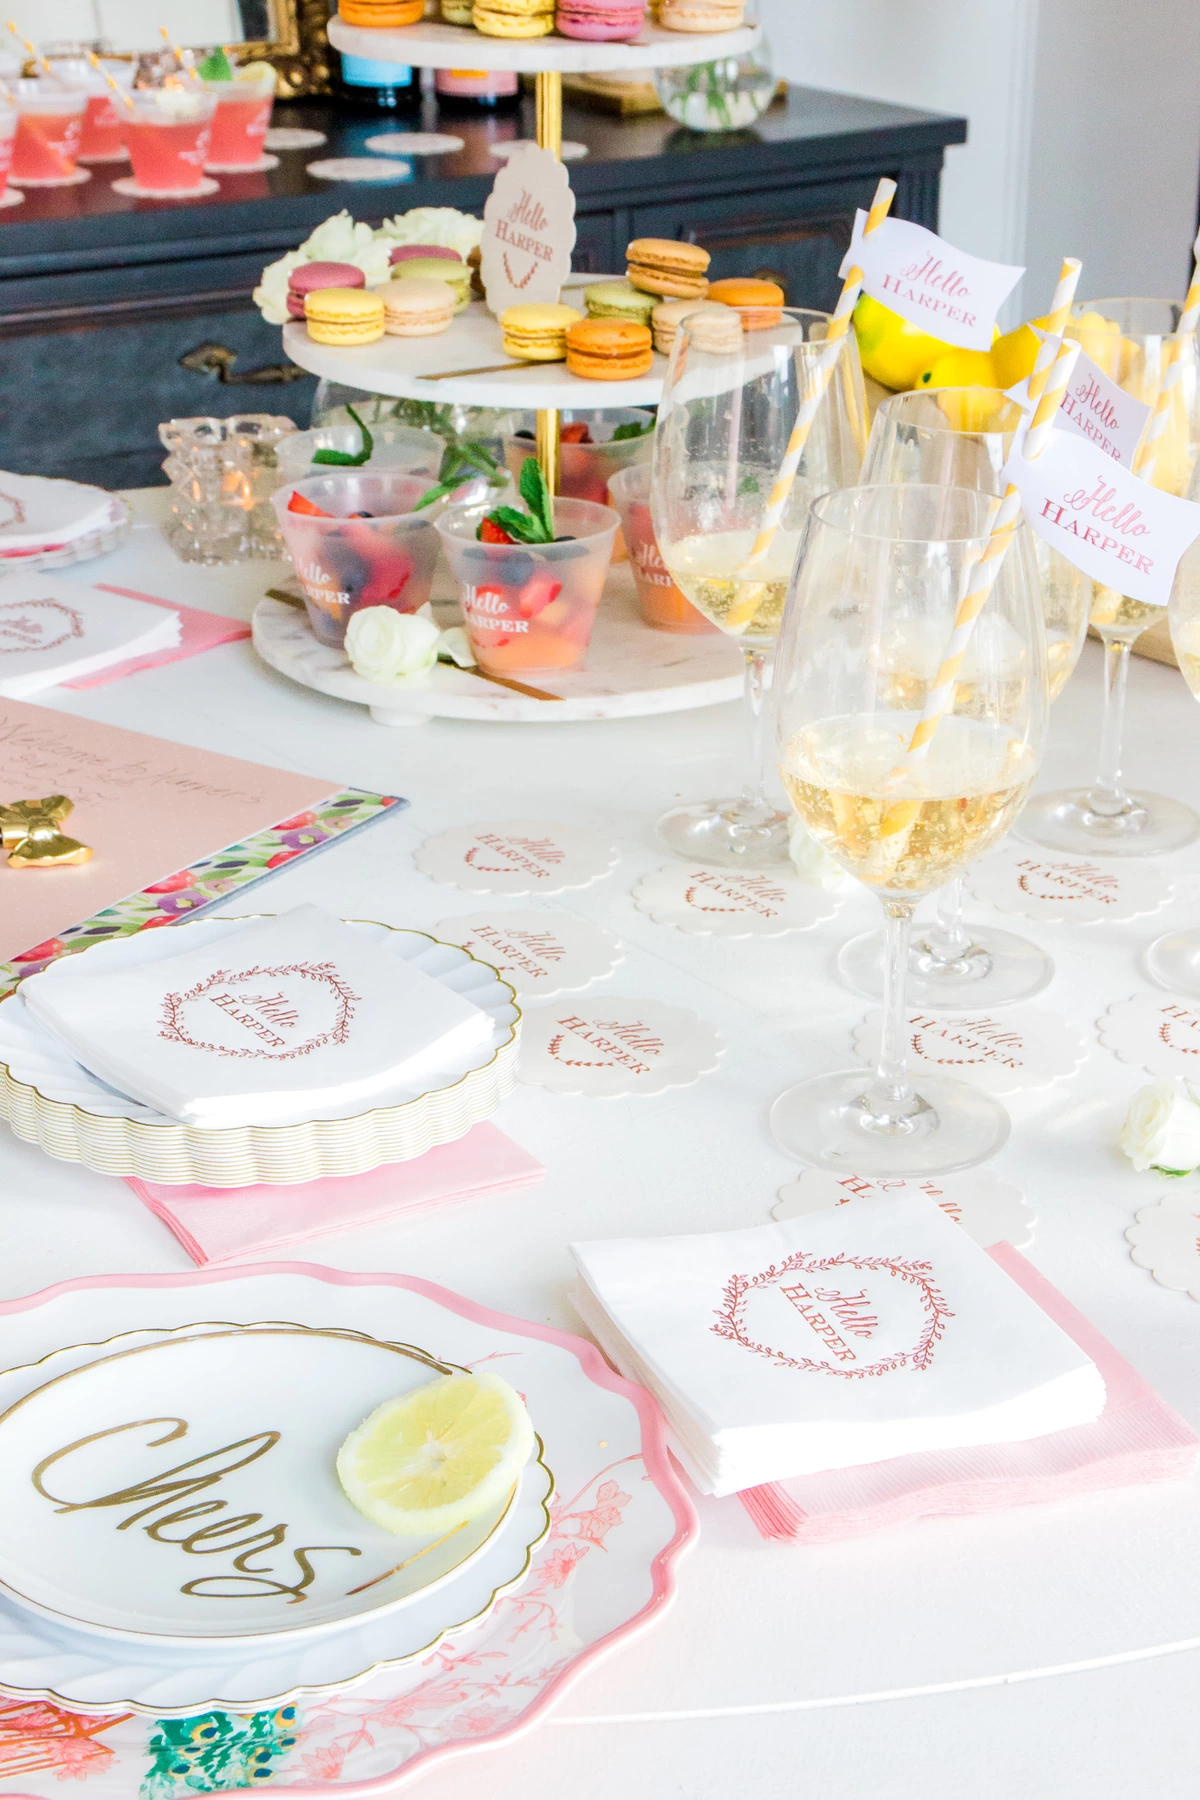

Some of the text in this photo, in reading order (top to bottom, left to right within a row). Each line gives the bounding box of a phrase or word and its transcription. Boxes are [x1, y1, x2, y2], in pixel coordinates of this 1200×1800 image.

[507, 189, 549, 231] Hello
[495, 219, 554, 261] HARPER
[900, 250, 971, 297] Hello
[882, 273, 977, 327] HARPER
[1075, 373, 1119, 430] Hello
[1059, 390, 1121, 461] HARPER
[1063, 475, 1150, 537] Hello
[1038, 497, 1154, 575] HARPER
[474, 833, 550, 878] HARPER
[506, 837, 566, 864] Hello
[689, 871, 778, 918] HARPER
[720, 873, 788, 902] Hello
[1013, 859, 1118, 904] HARPER
[1045, 861, 1120, 889] Hello
[470, 925, 548, 978] HARPER
[504, 931, 566, 962] Hello
[209, 993, 286, 1047] HARPER
[239, 991, 299, 1028] Hello
[940, 1015, 1024, 1048] Hello
[556, 1014, 650, 1075] HARPER
[592, 1019, 664, 1056] Hello
[905, 1015, 1023, 1068] HARPER
[779, 1282, 857, 1361] HARPER
[813, 1288, 879, 1339] Hello
[31, 1417, 362, 1605] Cheers
